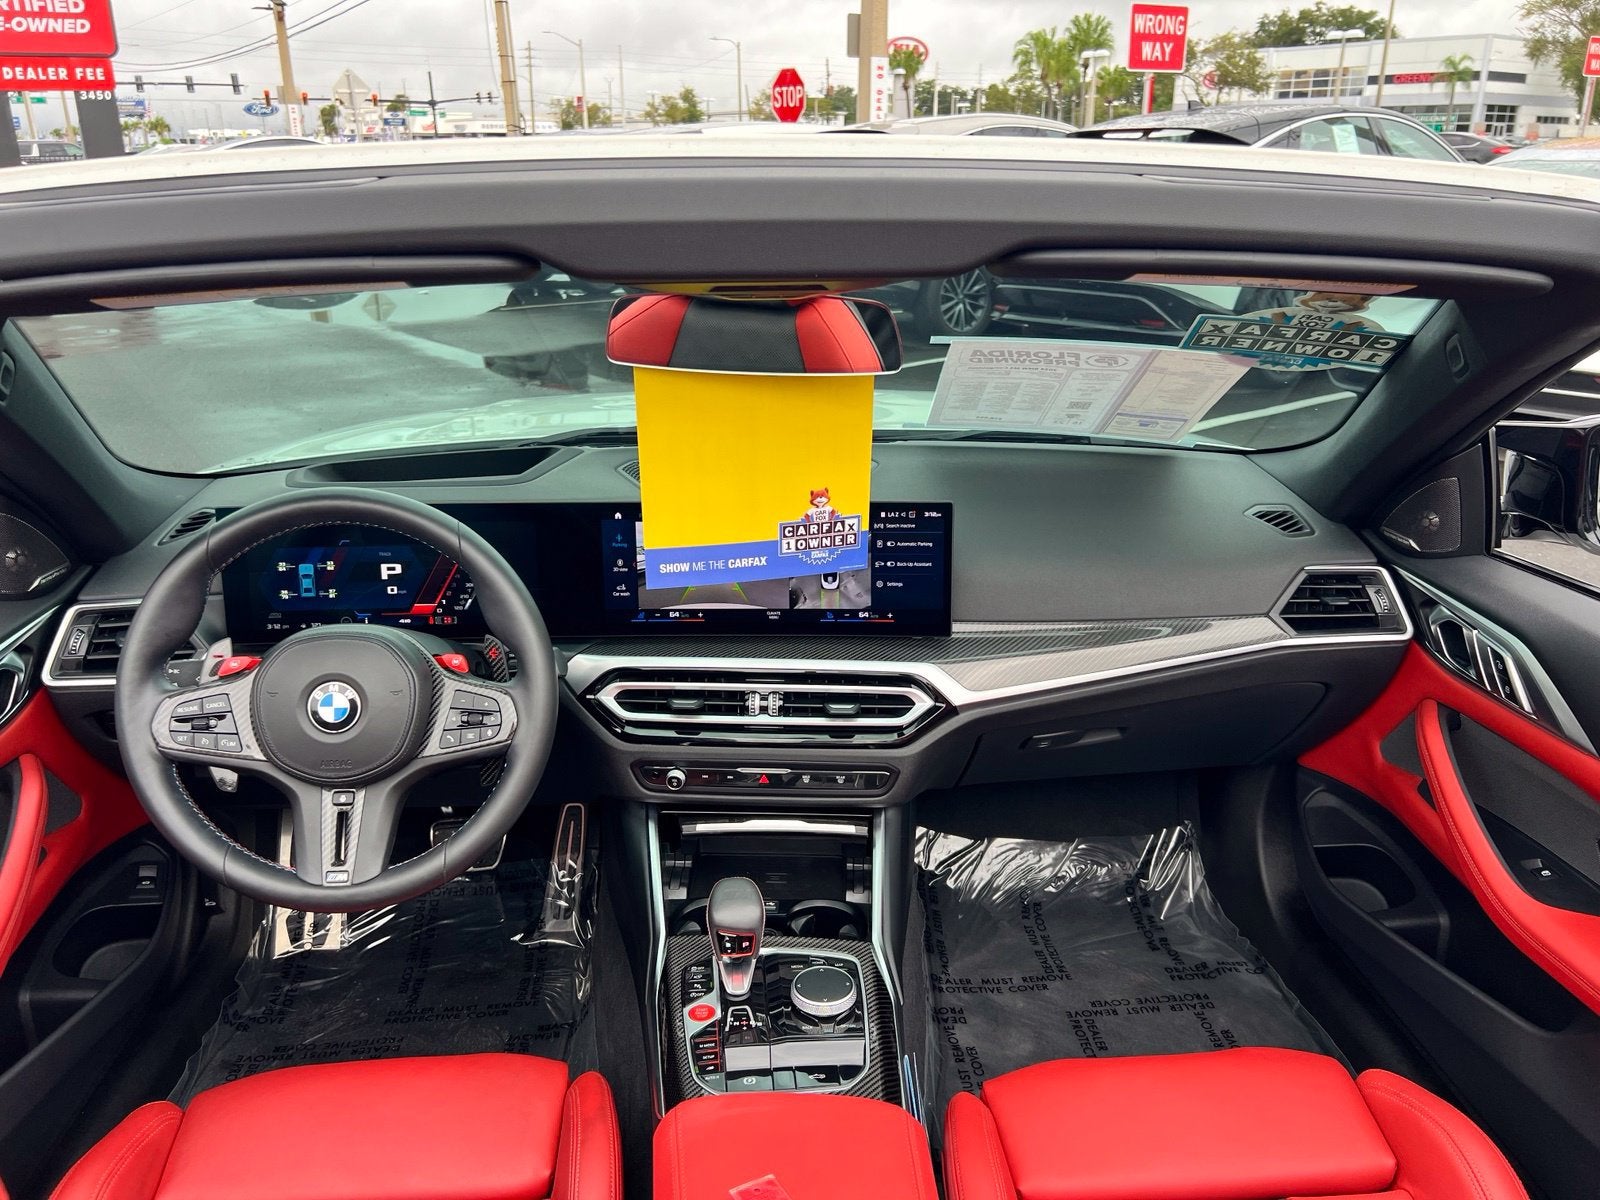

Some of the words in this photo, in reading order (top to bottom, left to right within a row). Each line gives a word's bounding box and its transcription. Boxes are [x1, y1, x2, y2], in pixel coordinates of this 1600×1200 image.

[1134, 13, 1185, 36] WRONG
[1141, 42, 1174, 62] WAY
[2, 66, 69, 80] DEALER
[75, 67, 106, 81] FEE
[80, 91, 112, 100] 3450
[774, 86, 803, 108] STOP
[784, 522, 857, 538] CARFAX
[380, 563, 403, 580] P
[659, 562, 690, 574] SHOW
[692, 561, 706, 571] ME
[709, 559, 725, 570] THE
[728, 556, 768, 569] CARFAX
[314, 684, 357, 700] BMW
[177, 705, 199, 713] RESUME
[981, 976, 1014, 986] MUST
[1021, 973, 1073, 984] REMOVE
[1008, 983, 1049, 993] COVER
[1089, 997, 1131, 1008] COVER
[1137, 992, 1210, 1005] PROTECTIVE
